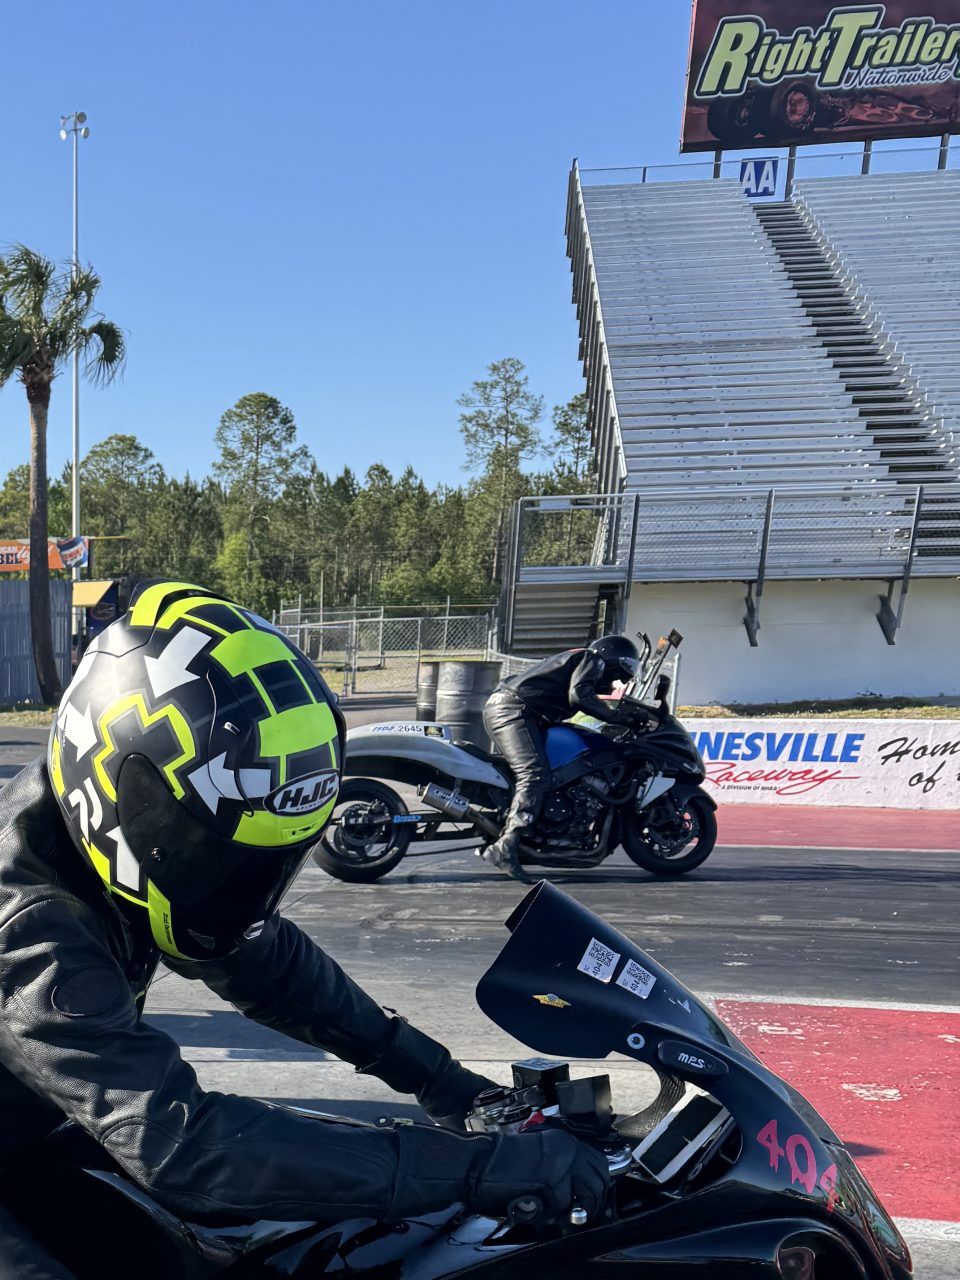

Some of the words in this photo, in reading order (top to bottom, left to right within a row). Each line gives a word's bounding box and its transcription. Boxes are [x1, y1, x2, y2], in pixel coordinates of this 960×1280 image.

[844, 64, 951, 88] Nationwide
[741, 160, 775, 194] AA
[398, 725, 422, 733] 2645
[909, 760, 946, 793] of
[278, 773, 337, 810] HJC
[677, 1052, 705, 1069] MPS
